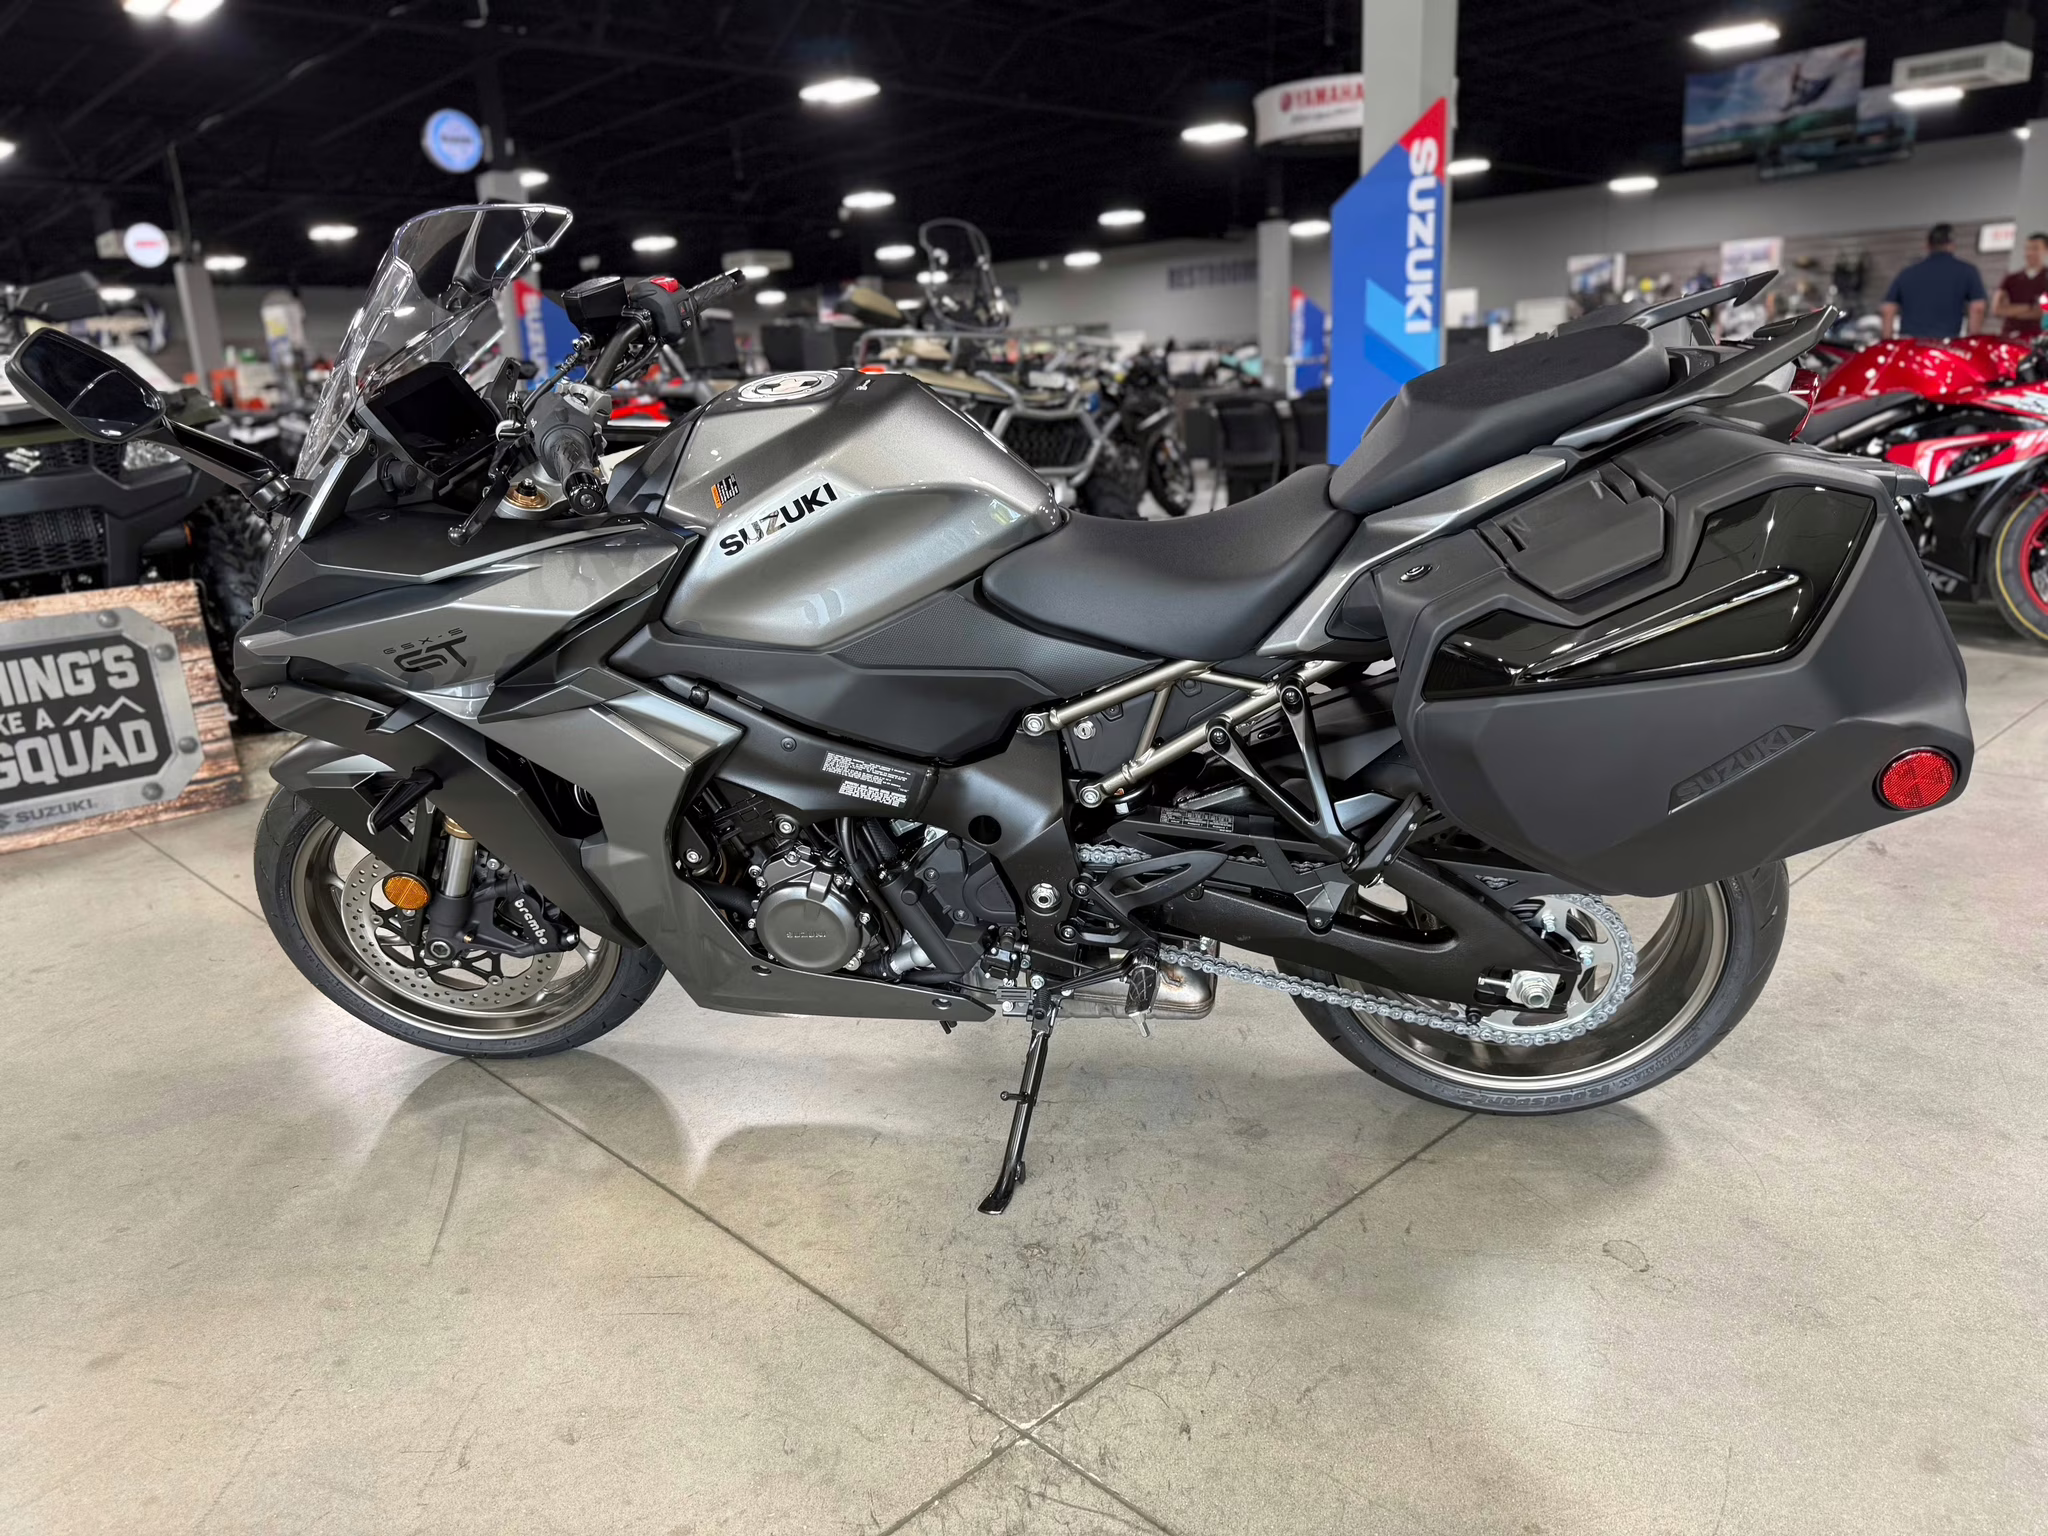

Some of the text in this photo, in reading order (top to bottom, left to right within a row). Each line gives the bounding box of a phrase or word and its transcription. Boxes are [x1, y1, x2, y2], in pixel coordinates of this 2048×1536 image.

[1405, 136, 1439, 334] SUZUKI
[719, 482, 838, 556] SUZUKI
[383, 627, 464, 655] GSX-S
[393, 635, 467, 673] GT
[36, 707, 55, 730] A
[1676, 725, 1796, 802] SUZUKI
[15, 799, 94, 823] SUZUKI
[514, 898, 548, 945] brembo
